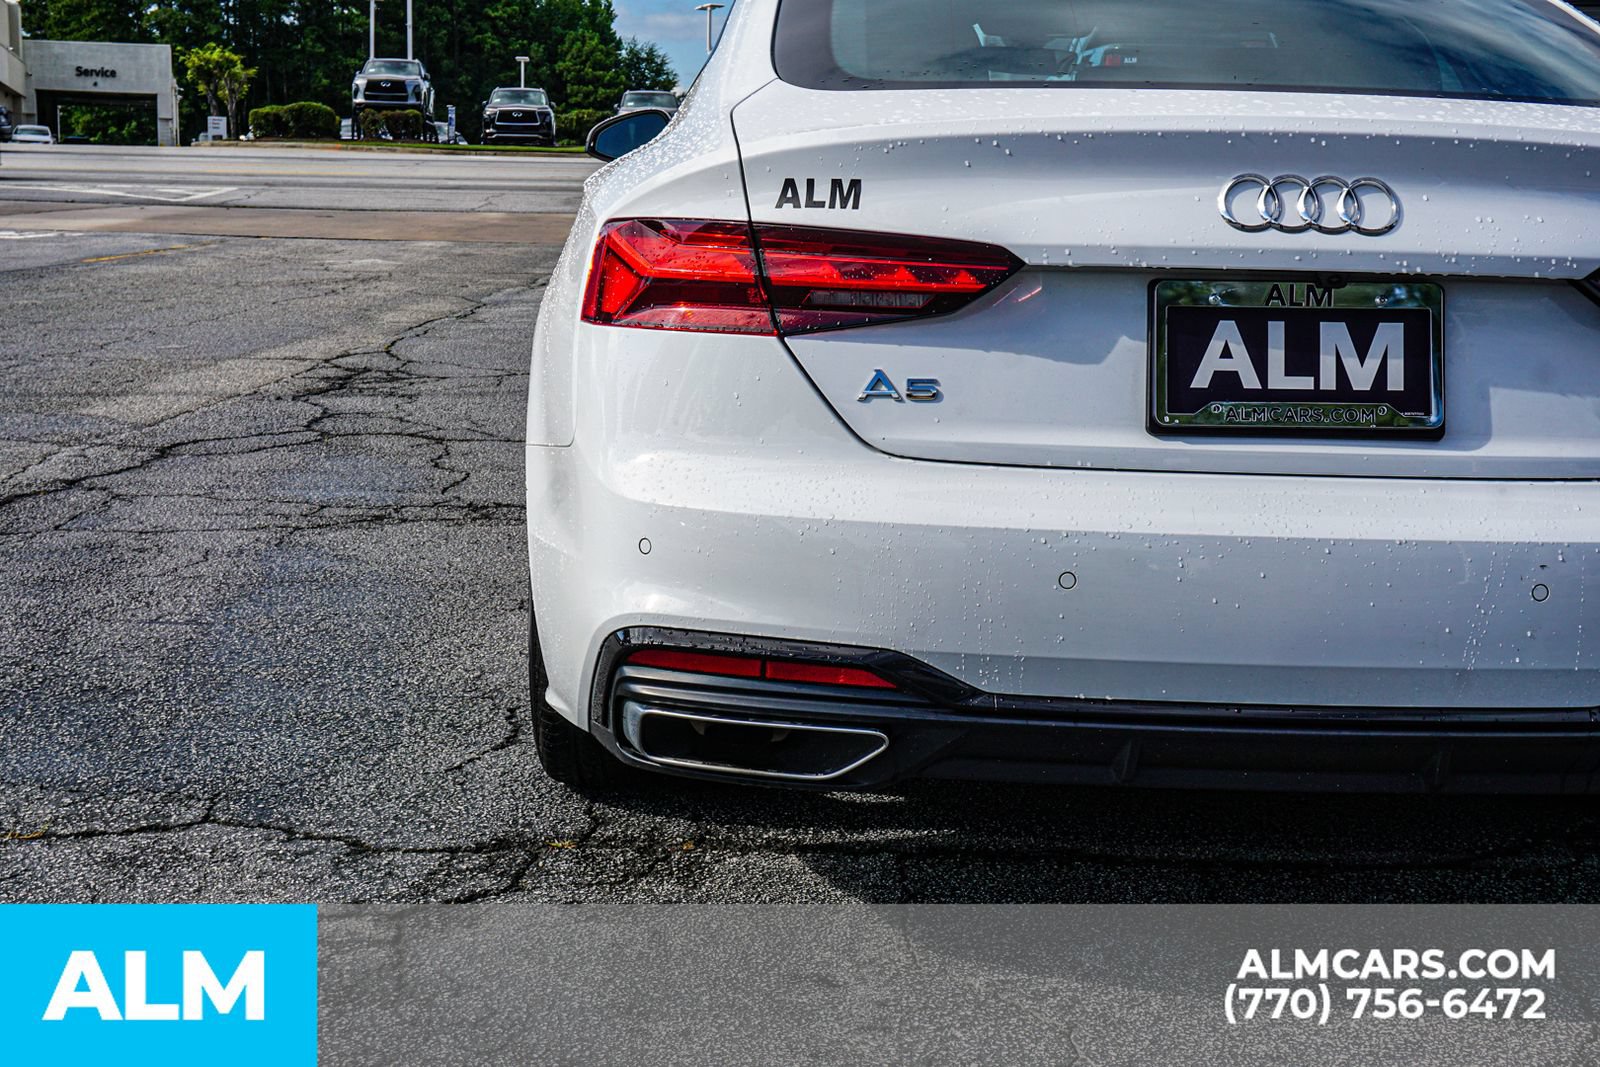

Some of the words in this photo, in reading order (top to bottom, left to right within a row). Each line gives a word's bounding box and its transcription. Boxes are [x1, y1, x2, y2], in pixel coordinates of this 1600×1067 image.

[75, 66, 117, 78] Service
[775, 178, 862, 210] ALM
[1264, 282, 1335, 307] ALM
[1189, 319, 1405, 392] ALM
[857, 368, 943, 402] A5
[1224, 406, 1377, 423] ALMCARS.COM
